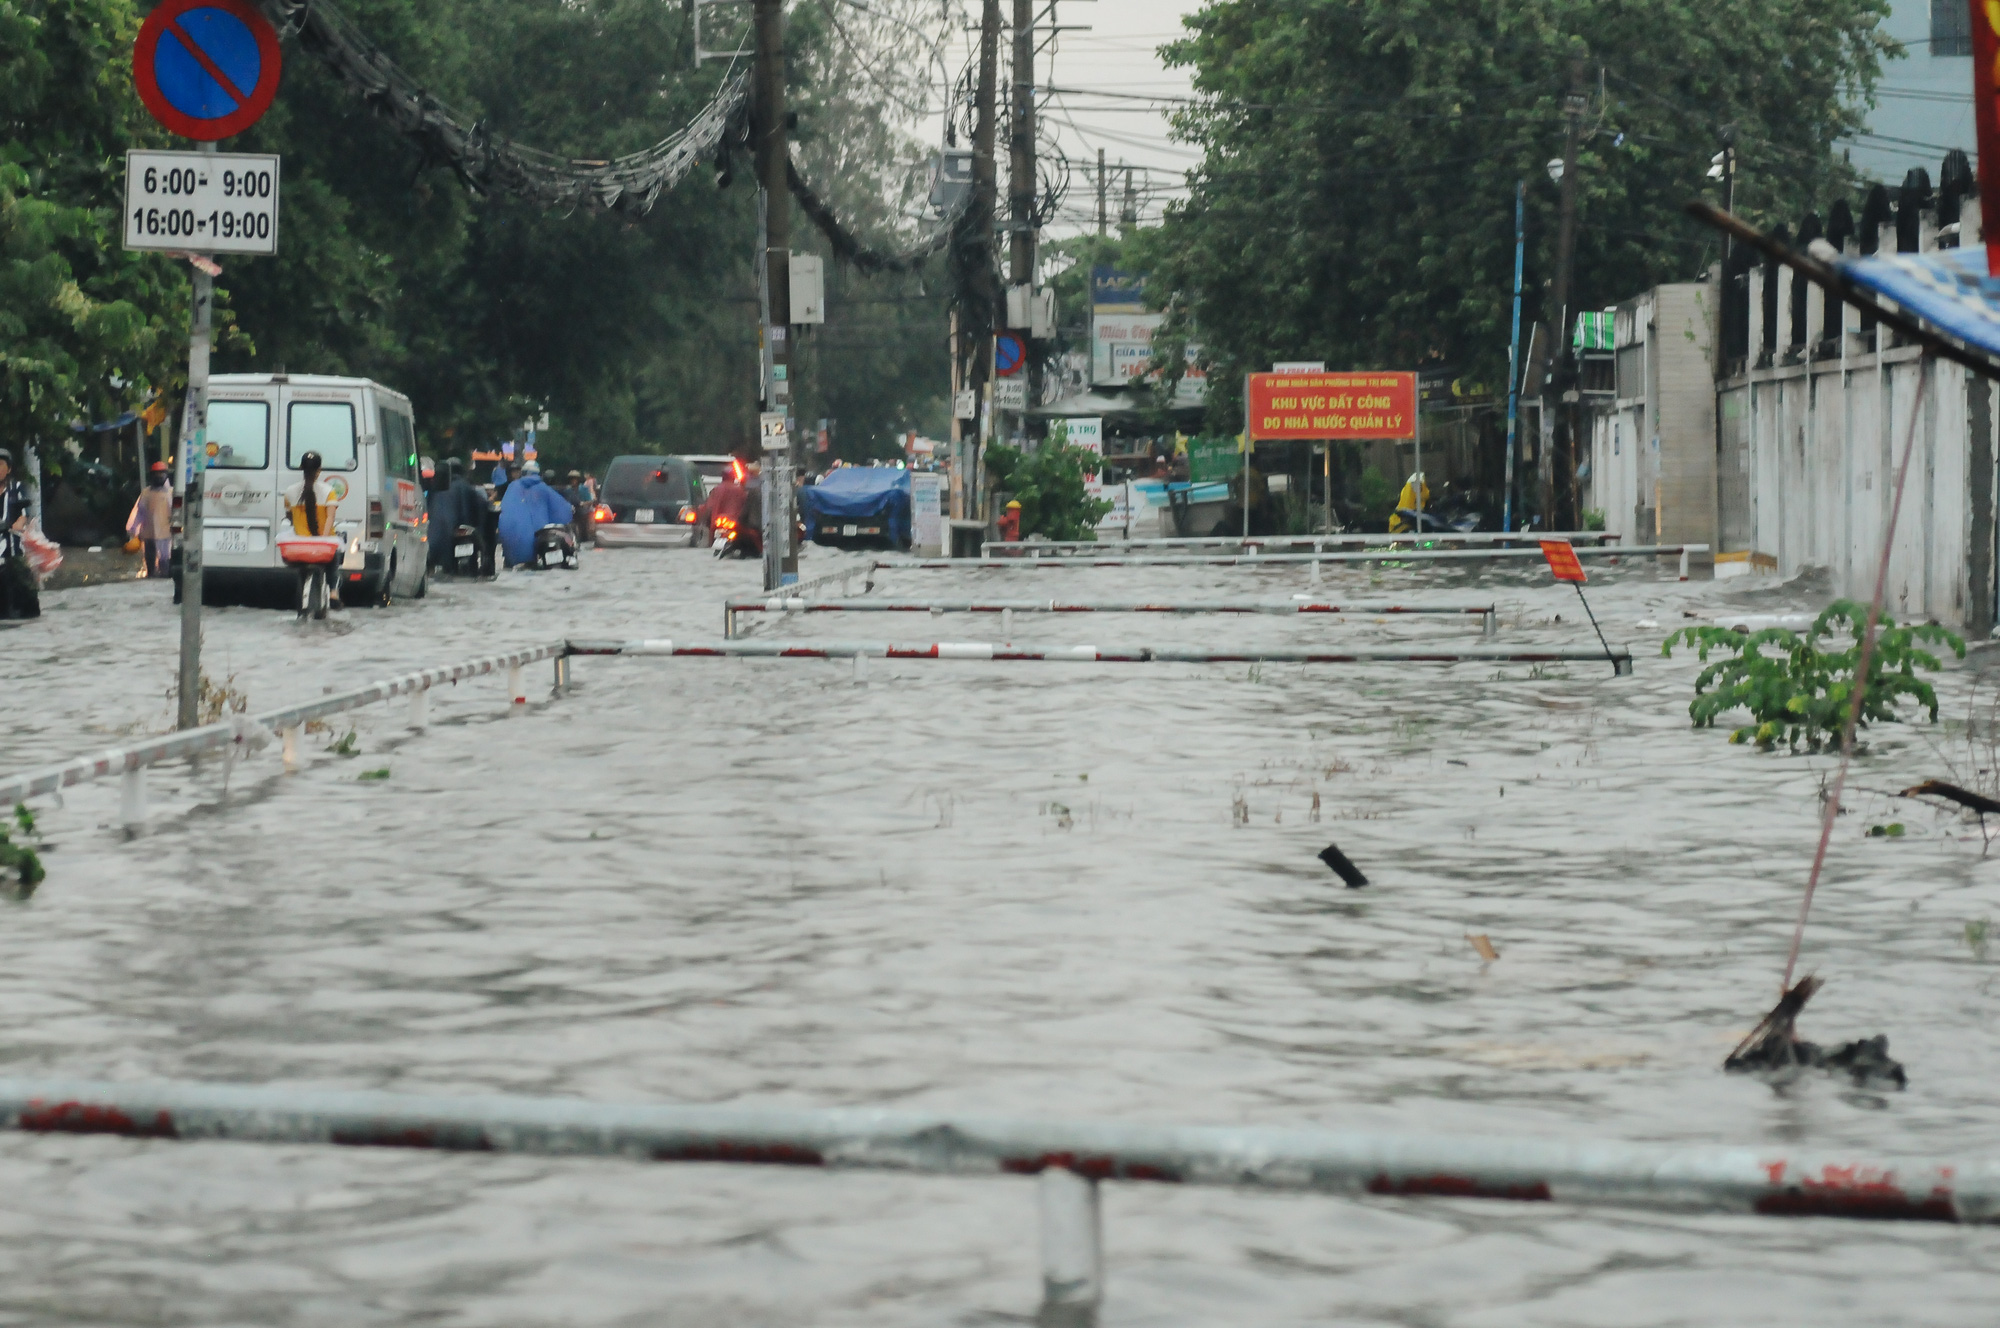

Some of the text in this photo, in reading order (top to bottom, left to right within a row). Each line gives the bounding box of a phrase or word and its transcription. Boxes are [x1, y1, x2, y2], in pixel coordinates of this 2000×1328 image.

[223, 170, 270, 198] 9:00
[1272, 393, 1391, 411] KHU VỰC ĐẤT CÔNG
[1264, 412, 1403, 430] DO NHÀ NƯỚC QUẢN LÝ
